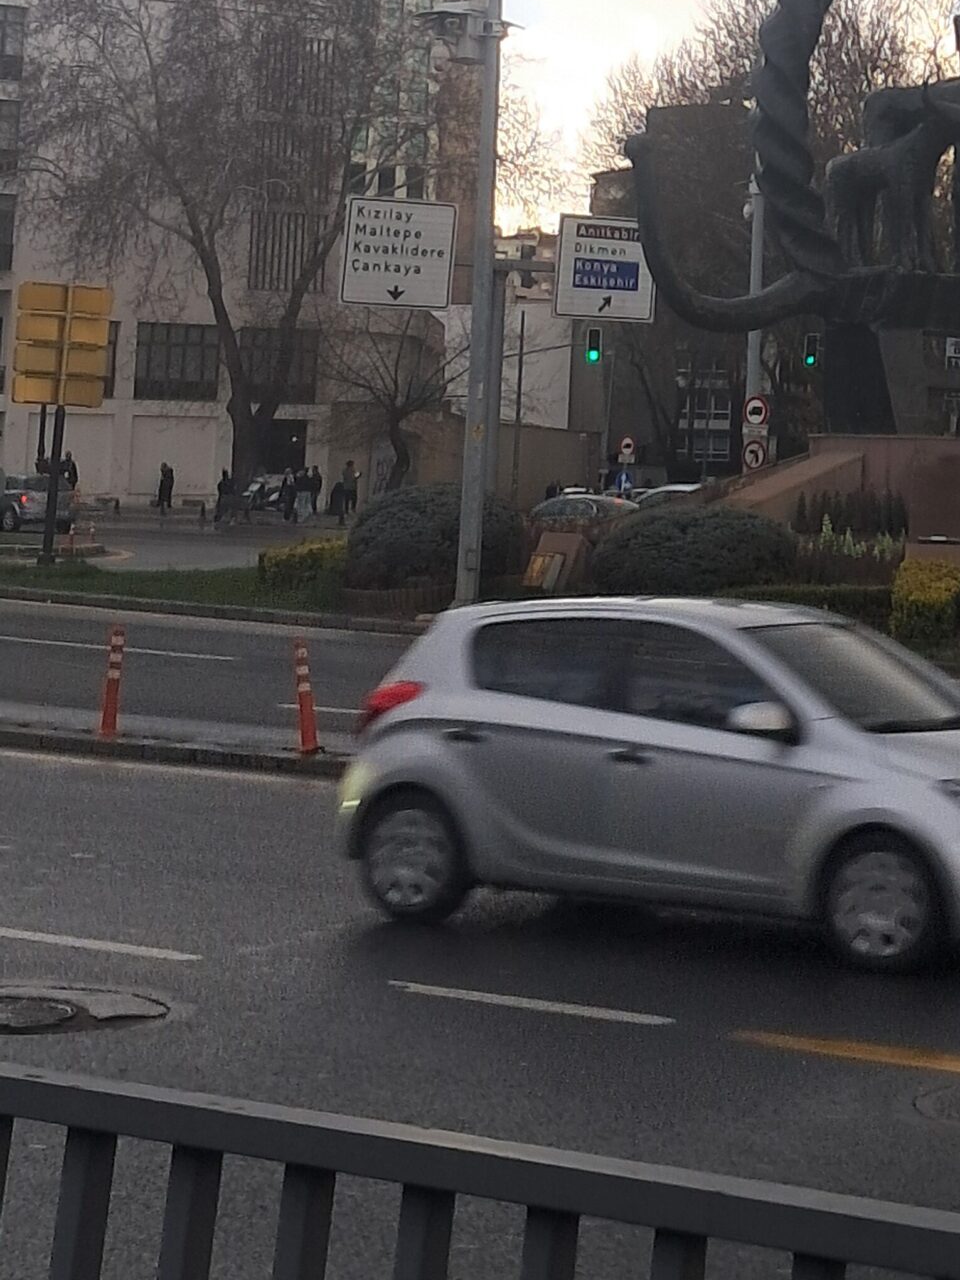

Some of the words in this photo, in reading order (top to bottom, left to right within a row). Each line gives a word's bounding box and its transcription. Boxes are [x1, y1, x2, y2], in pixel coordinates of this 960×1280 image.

[356, 205, 414, 223] Kızılay
[354, 223, 422, 240] Maltepe
[353, 241, 445, 258] Kavaklıdere
[574, 242, 626, 256] Dikmen
[351, 258, 422, 277] Çankaya
[576, 260, 618, 275] Konya
[574, 273, 636, 289] Eskişehir
